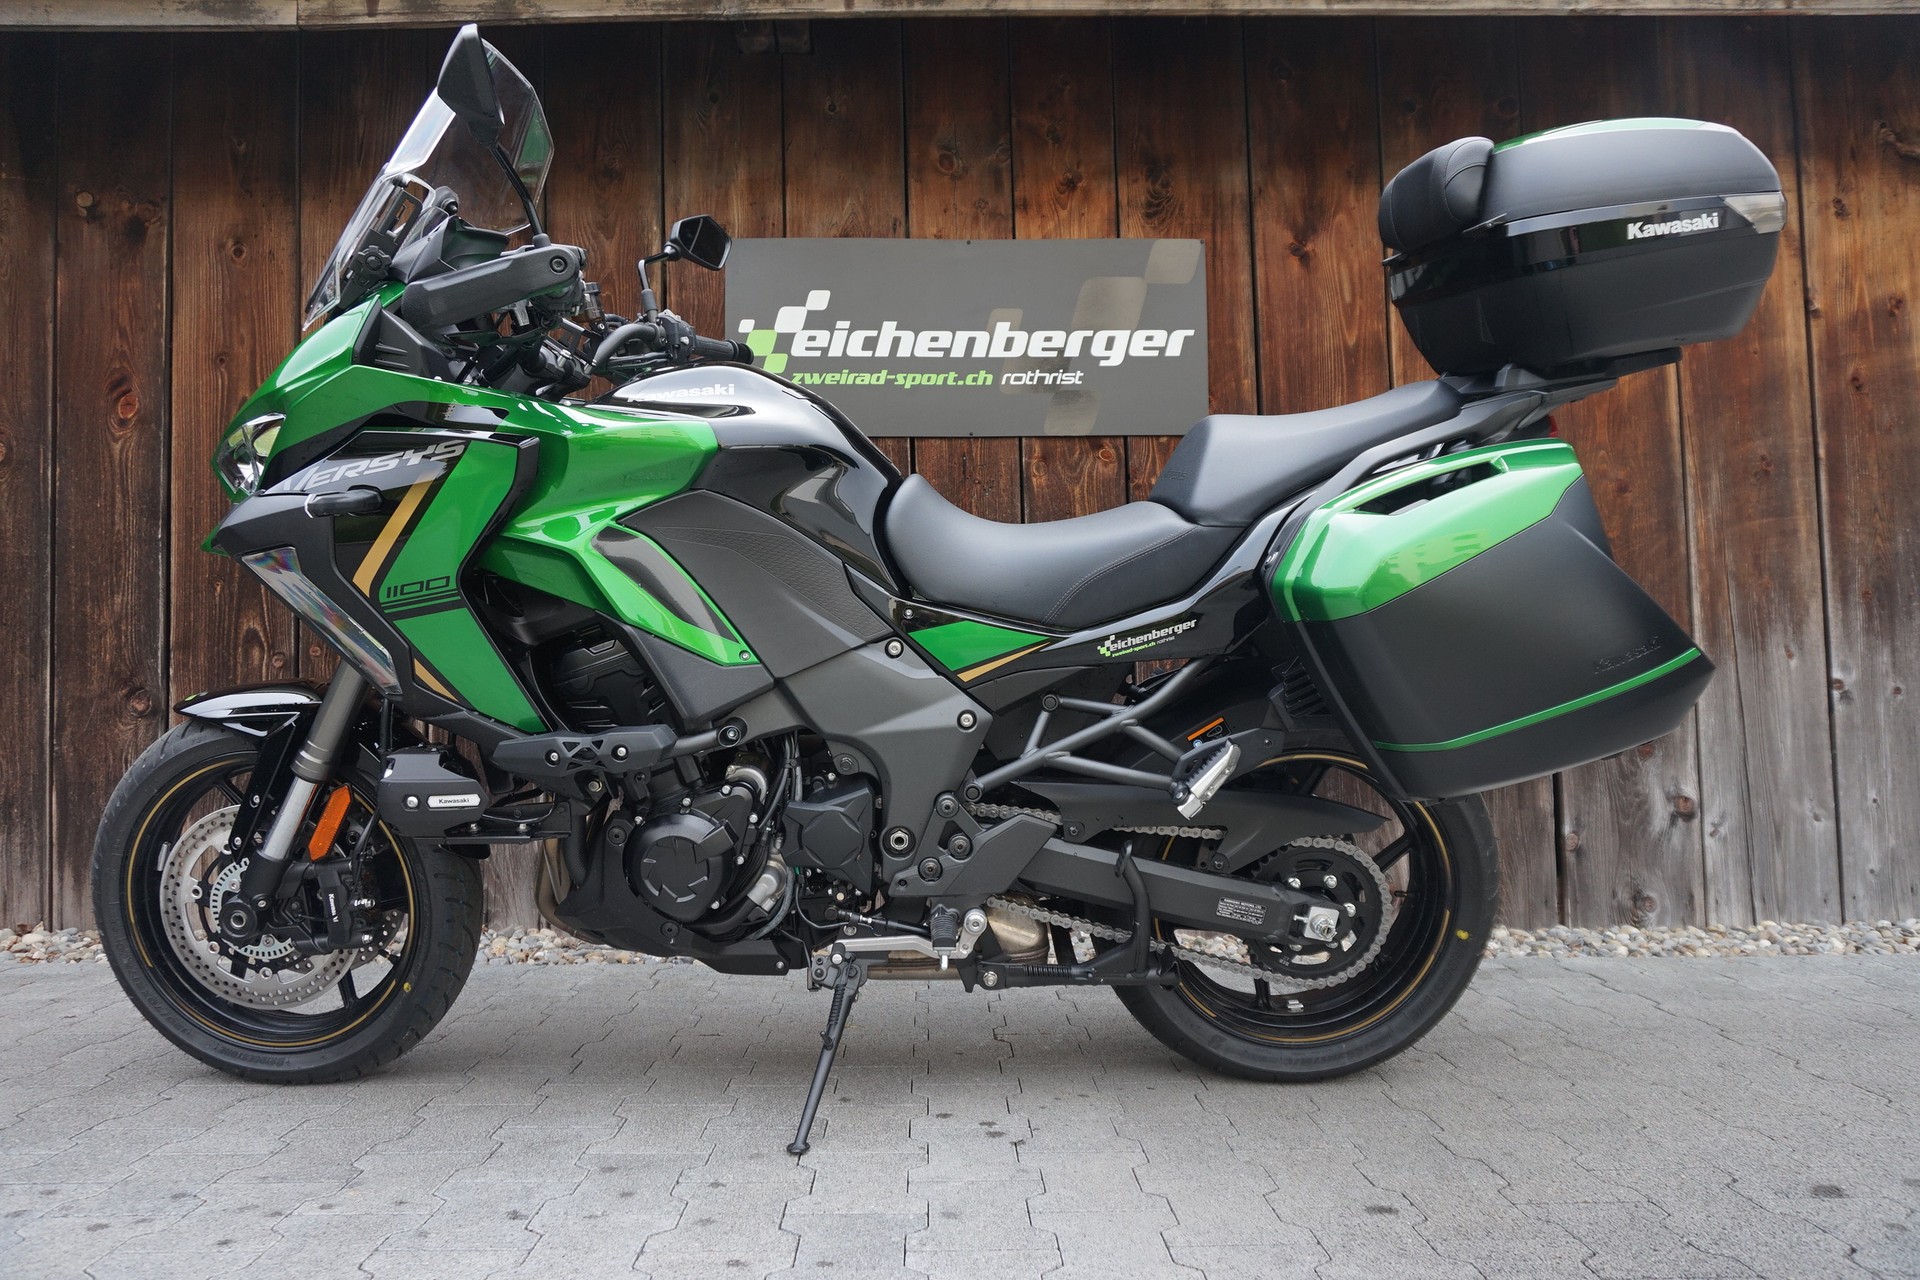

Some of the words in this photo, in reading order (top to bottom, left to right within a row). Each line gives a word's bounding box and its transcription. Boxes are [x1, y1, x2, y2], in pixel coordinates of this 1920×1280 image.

[1627, 213, 1719, 240] Kawasaki
[790, 321, 1195, 367] eichenberger
[792, 370, 993, 389] zweirad-sport.ch
[1002, 370, 1084, 385] rothrist
[283, 440, 467, 491] VERSYS
[386, 576, 450, 598] 1100
[1110, 619, 1197, 651] eichenberger
[438, 797, 470, 805] Kawasaki
